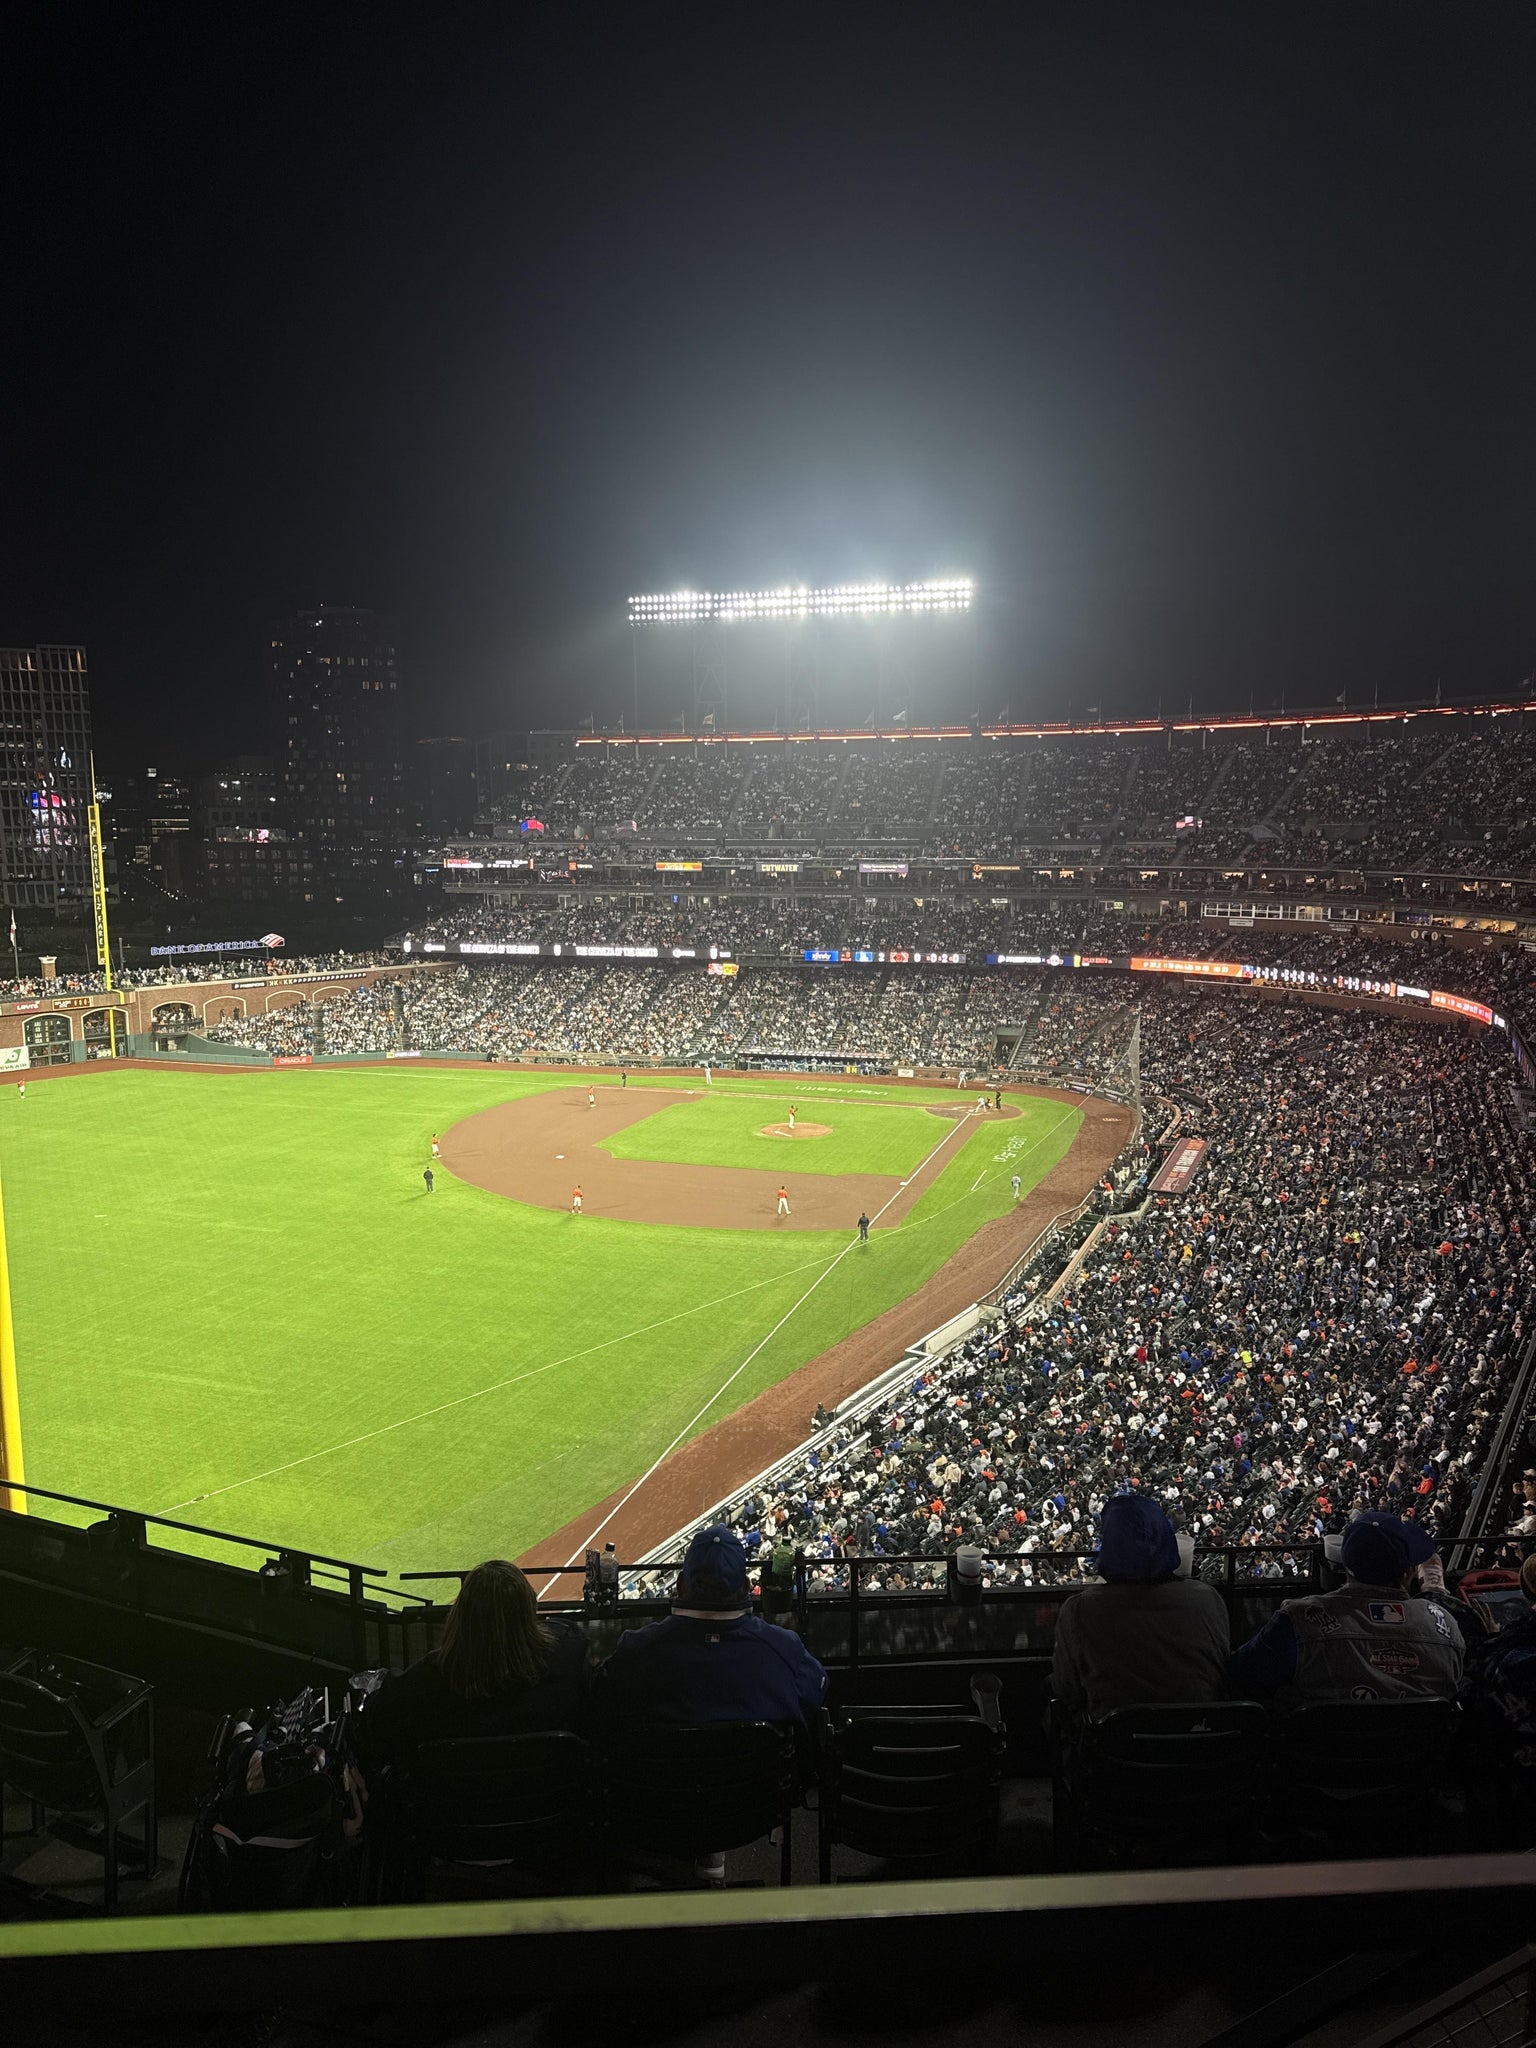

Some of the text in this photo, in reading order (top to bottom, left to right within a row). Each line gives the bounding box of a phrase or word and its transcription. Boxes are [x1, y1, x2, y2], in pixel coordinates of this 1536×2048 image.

[761, 864, 799, 872] CUTWATER
[151, 940, 259, 956] BANK OF AMERICA
[878, 952, 885, 962] 2
[97, 1049, 112, 1058] 309
